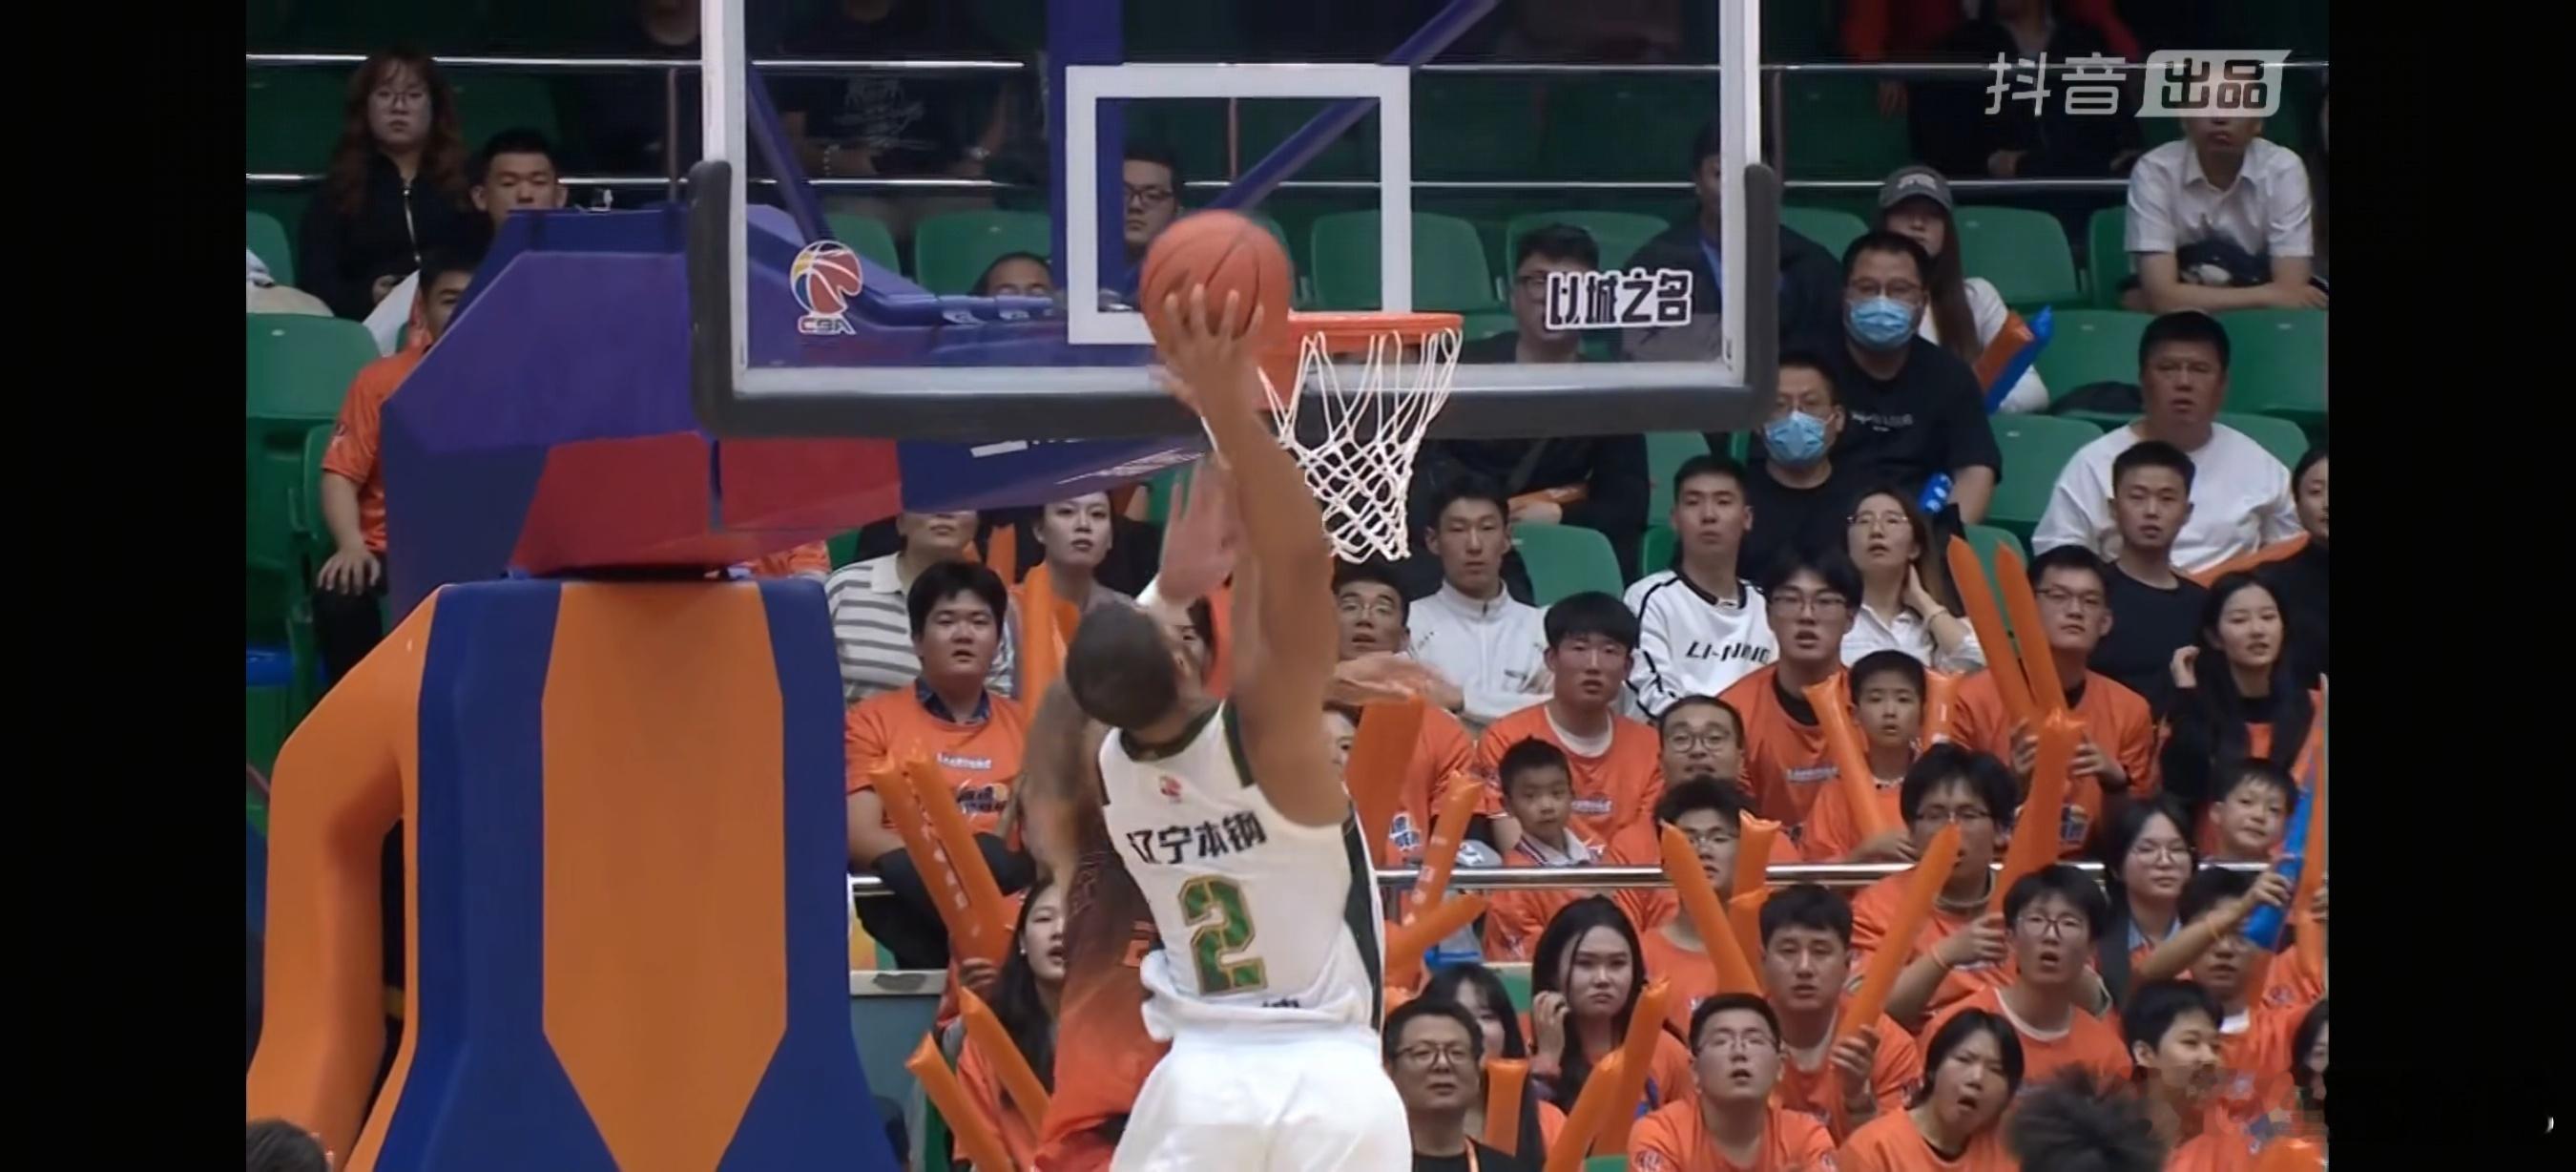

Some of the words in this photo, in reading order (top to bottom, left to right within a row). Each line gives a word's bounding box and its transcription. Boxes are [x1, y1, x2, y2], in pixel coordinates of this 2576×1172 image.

[799, 316, 855, 333] CBA
[1548, 270, 1691, 326] 以城之名
[1178, 873, 1269, 996] 2
